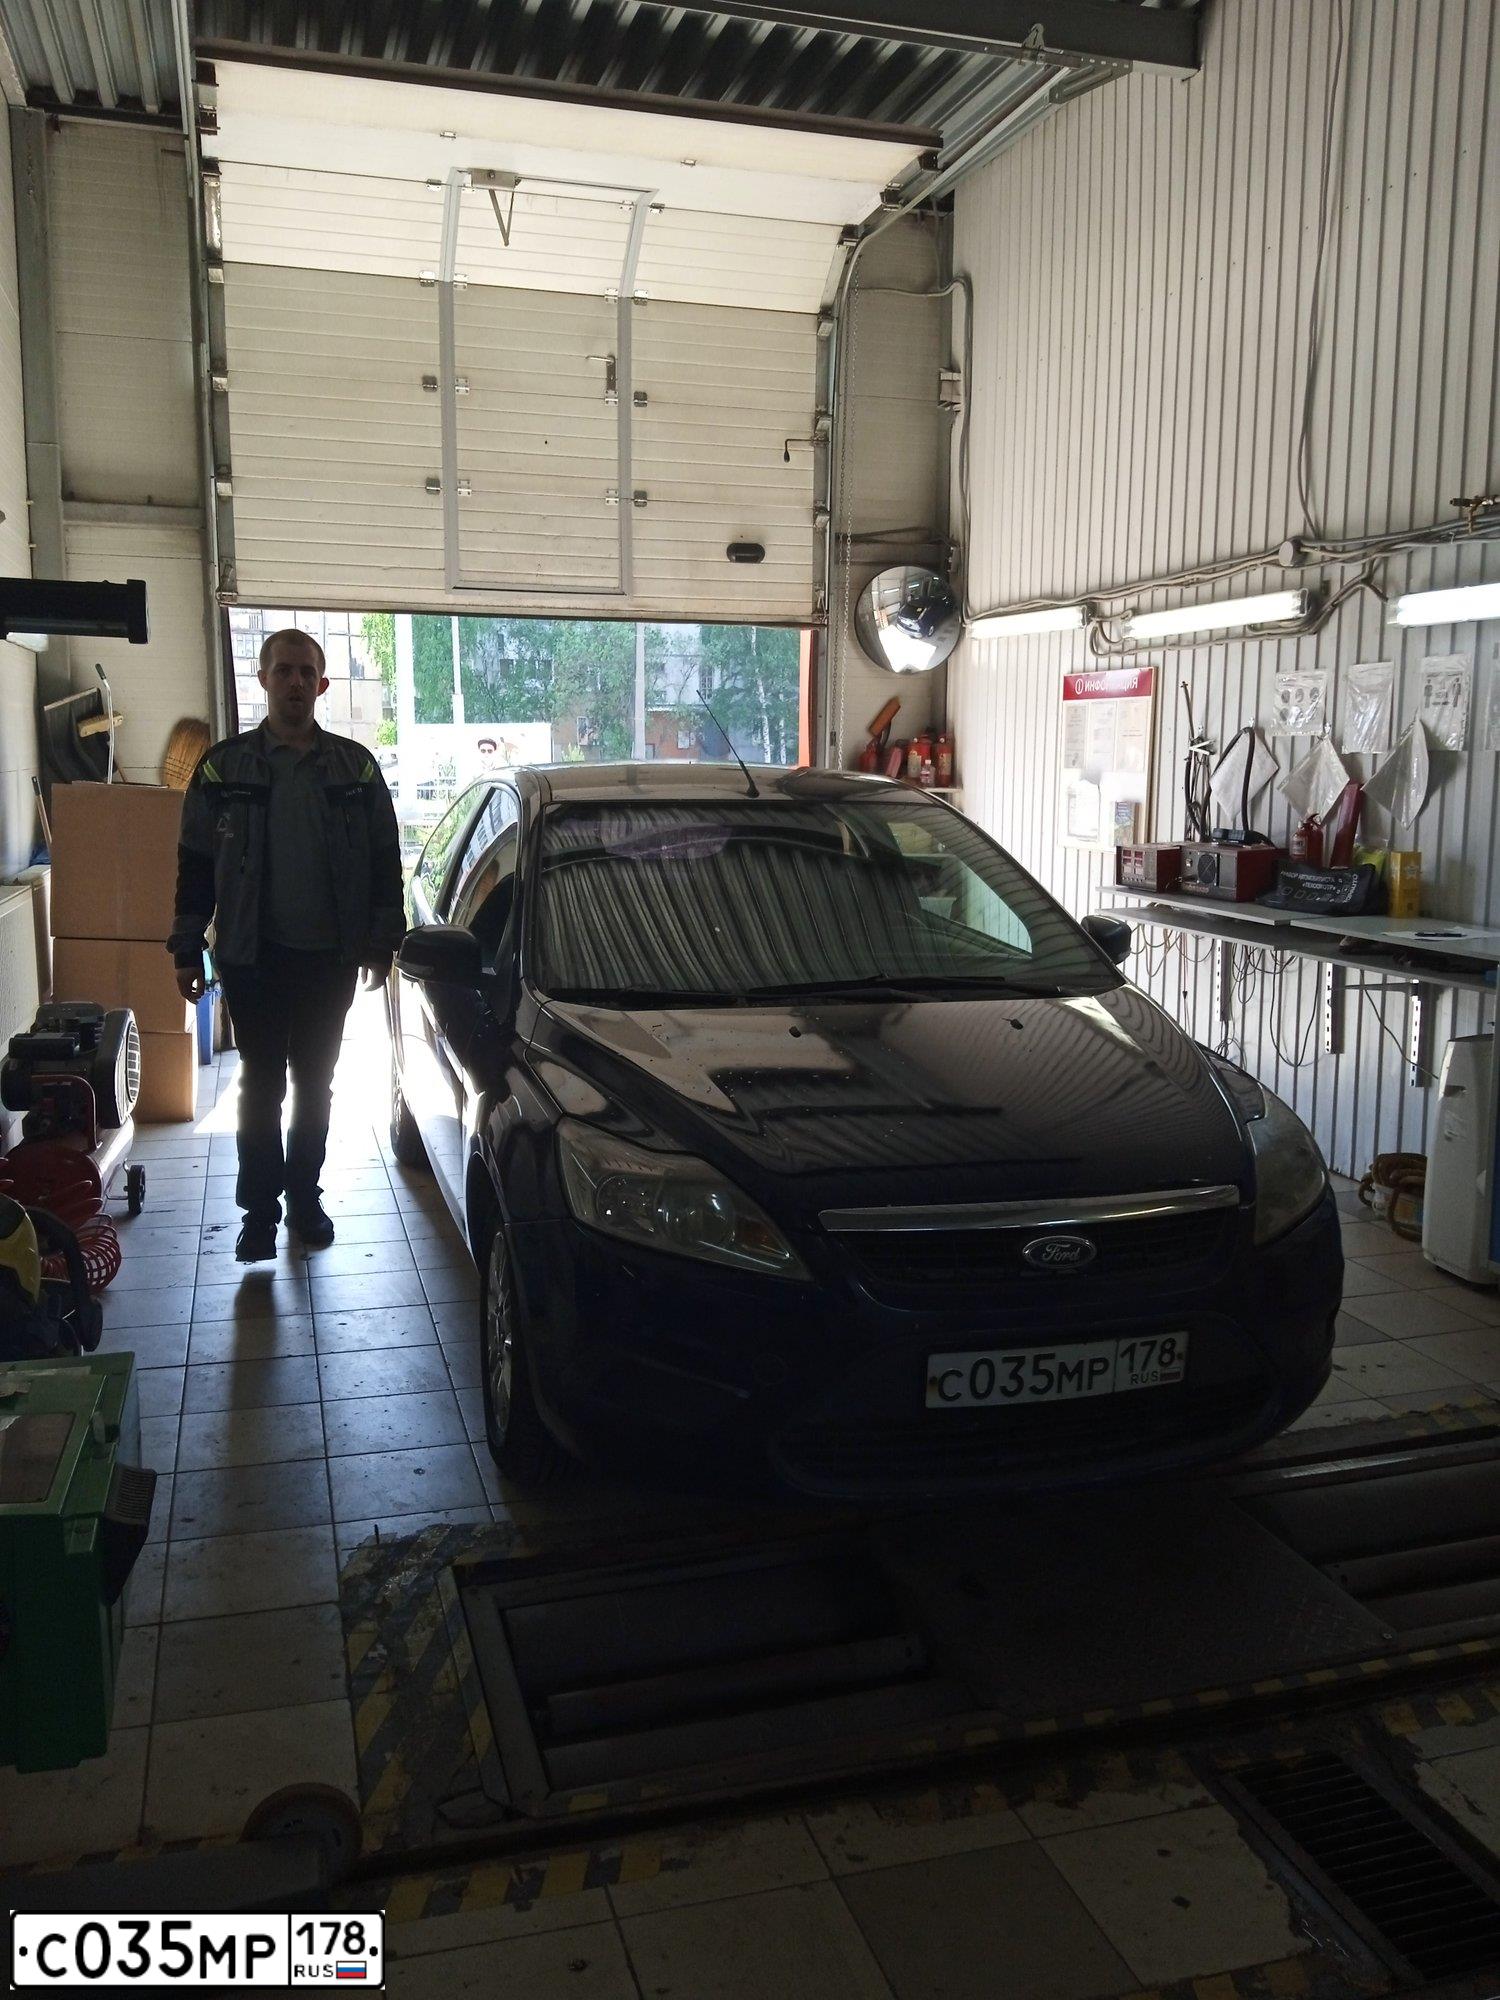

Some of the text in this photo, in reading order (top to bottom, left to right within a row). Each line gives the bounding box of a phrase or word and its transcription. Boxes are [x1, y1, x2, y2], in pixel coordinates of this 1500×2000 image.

[1085, 677, 1138, 693] ИНФОЦИЯ
[1041, 1243, 1080, 1262] Ford
[1120, 1338, 1177, 1373] 178
[1130, 1370, 1159, 1385] RUS
